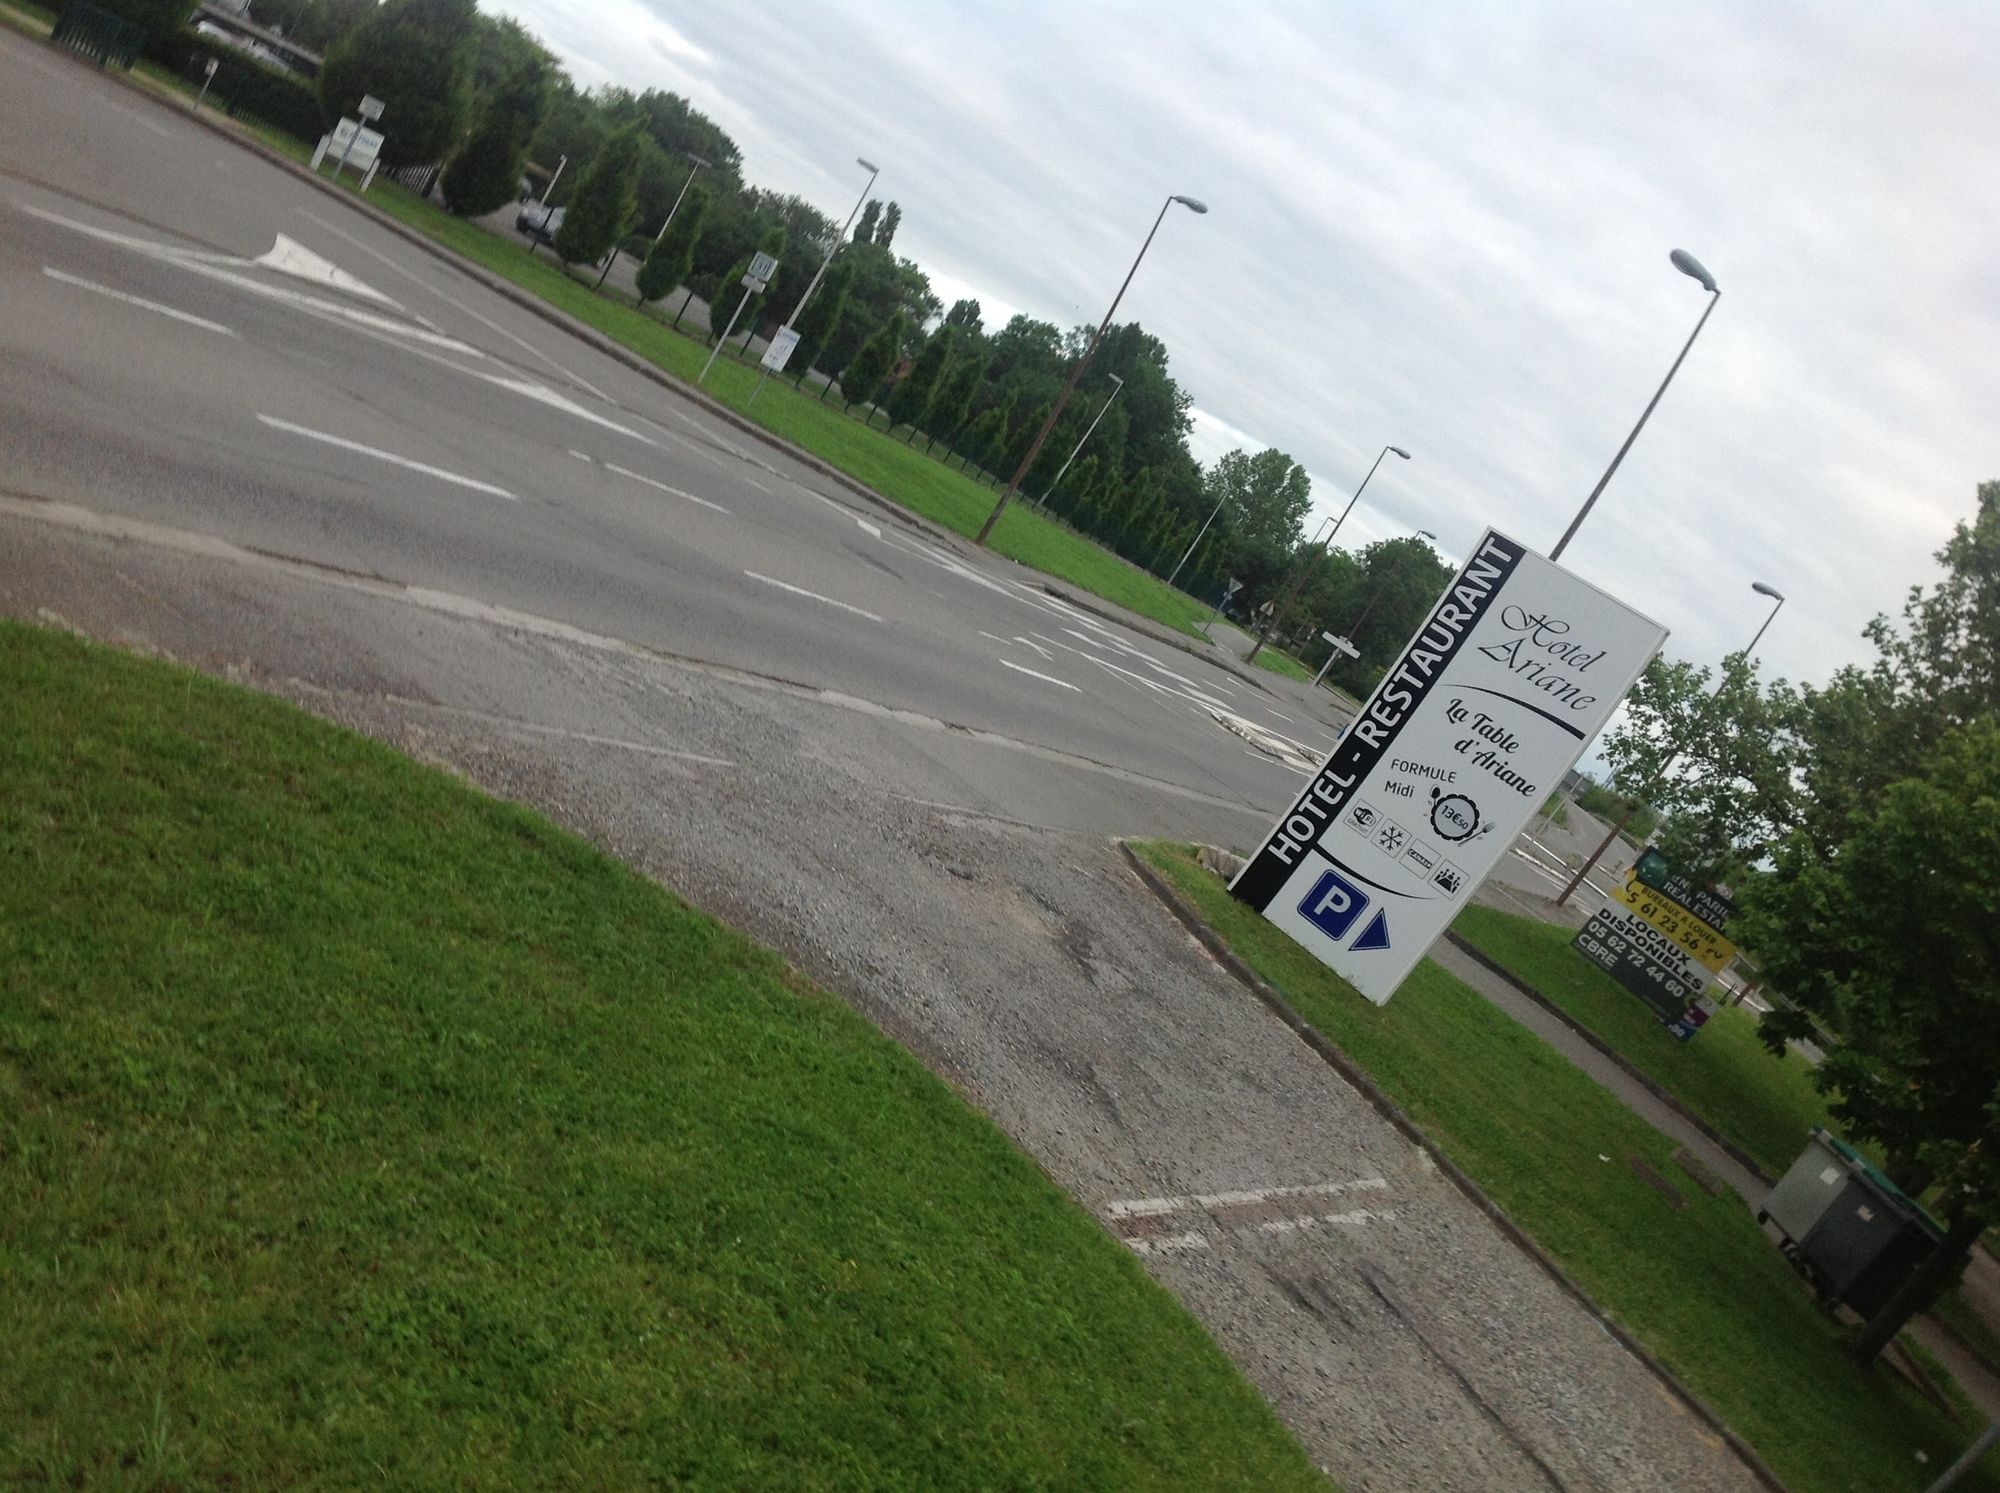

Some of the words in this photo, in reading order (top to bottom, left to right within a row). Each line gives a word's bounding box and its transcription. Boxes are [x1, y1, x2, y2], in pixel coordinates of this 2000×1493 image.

[1501, 605, 1607, 672] Hotel
[1268, 768, 1357, 865] HOTEL
[1354, 536, 1512, 749] RESTAURANT
[1477, 637, 1596, 710] Ariane
[1446, 698, 1469, 724] La
[1471, 713, 1519, 754] Table
[1384, 780, 1415, 798] Midi
[1390, 758, 1457, 784] FORMULE
[1313, 884, 1351, 915] P
[1641, 887, 1681, 918] BUREAUX
[1689, 922, 1718, 945] LOUER
[1663, 881, 1692, 907] REAL
[1578, 933, 1619, 967] CBRE
[1599, 908, 1703, 990] DISPONIBLES
[1626, 914, 1690, 966] LOCAUX
[1641, 902, 1658, 918] 61
[1659, 915, 1679, 933] 23
[1680, 931, 1699, 950] 56
[1588, 921, 1608, 939] 05
[1607, 936, 1627, 953] 62
[1627, 949, 1646, 967] 72
[1646, 966, 1665, 983] 44
[1664, 980, 1685, 998] 60
